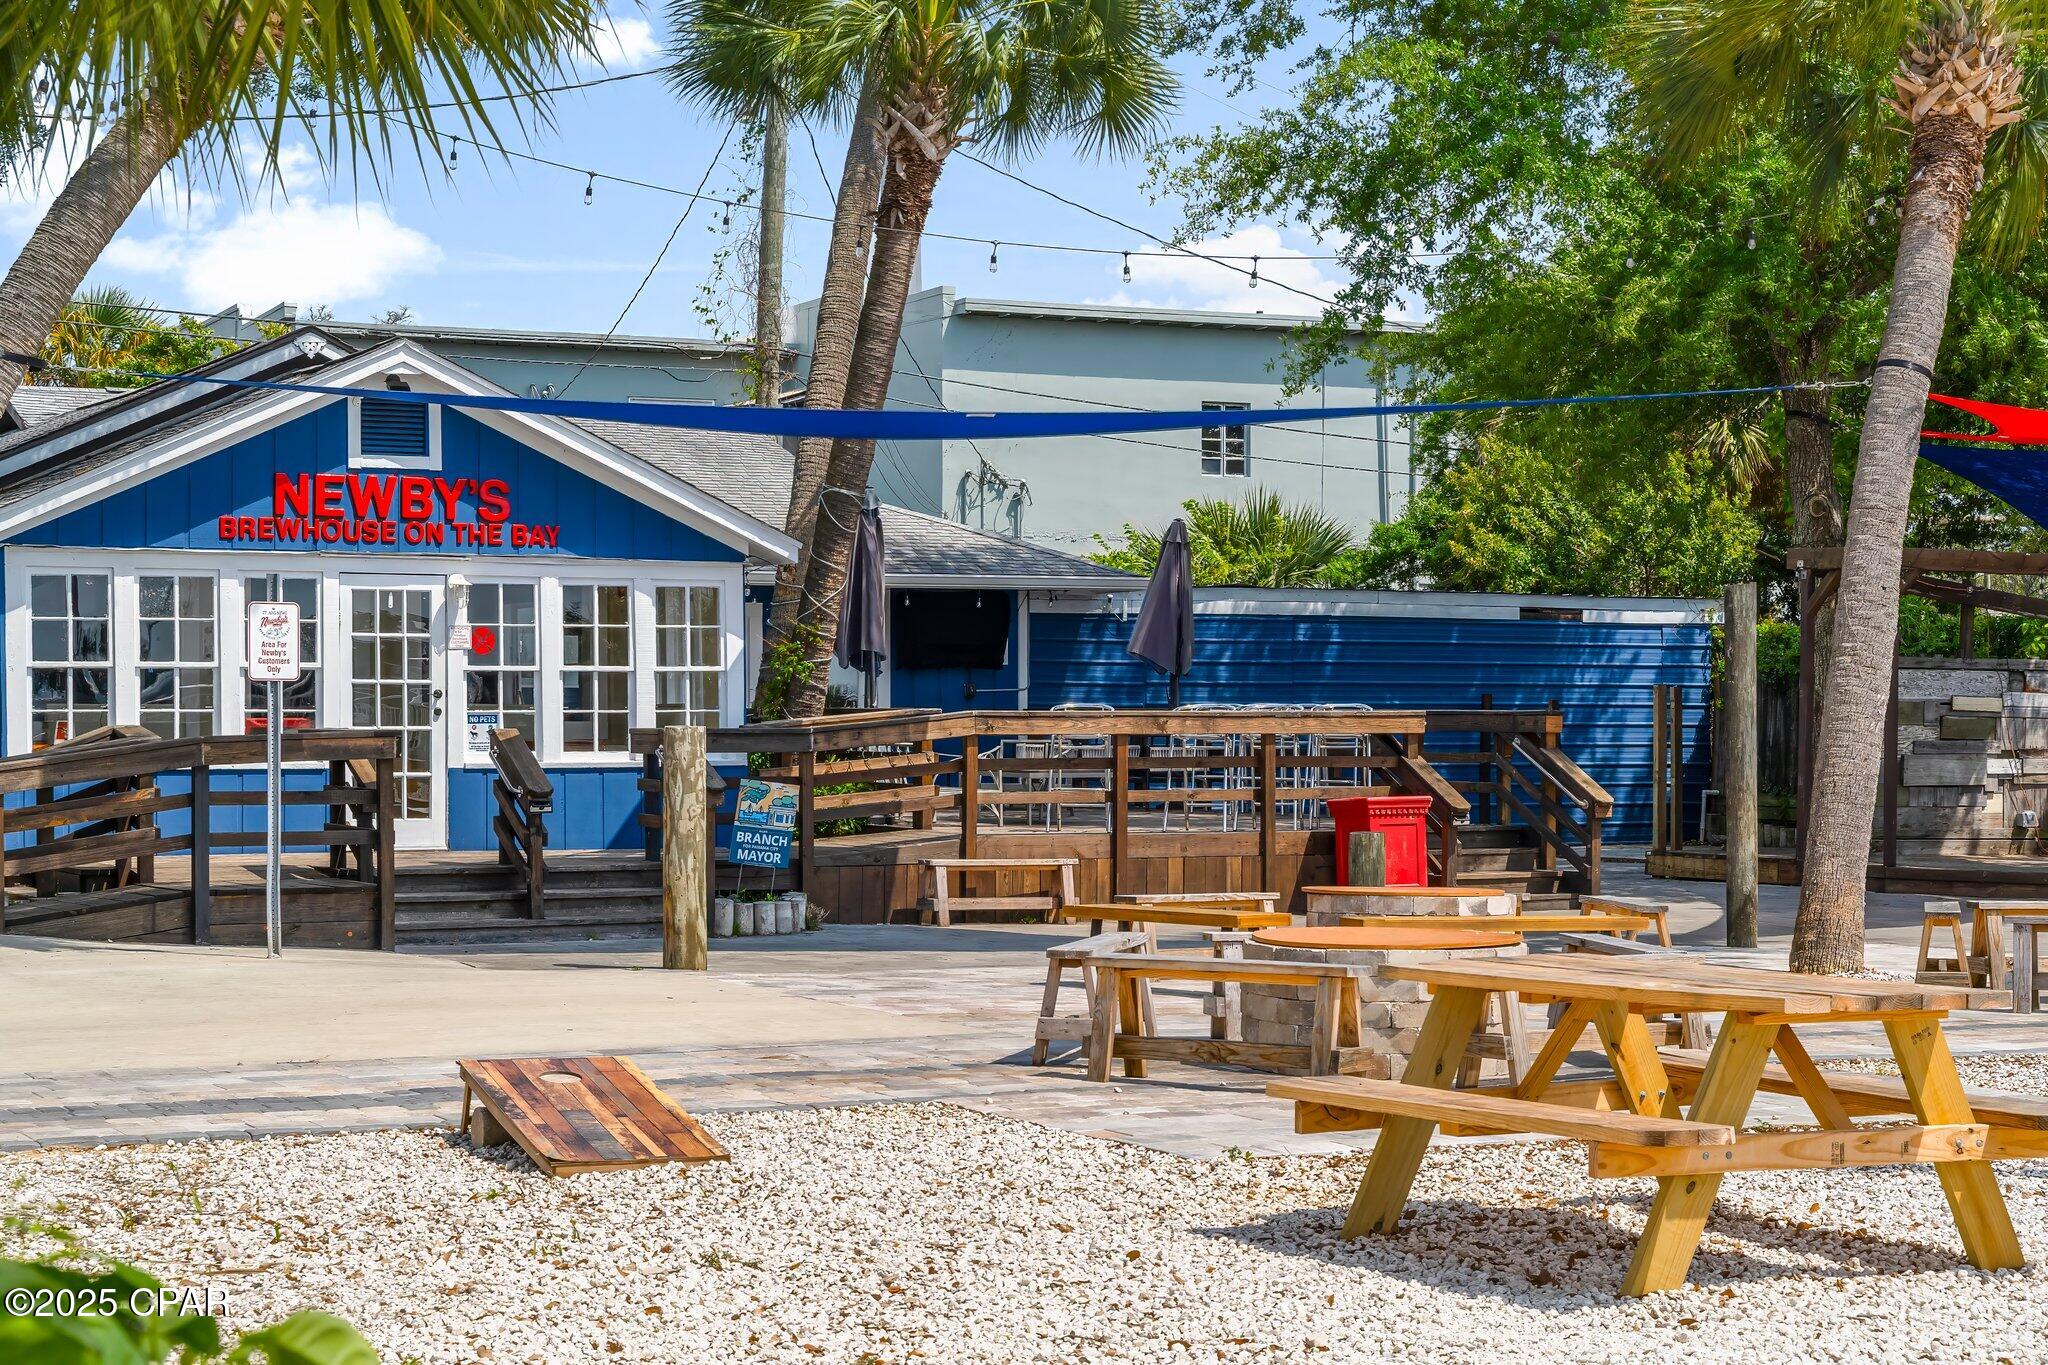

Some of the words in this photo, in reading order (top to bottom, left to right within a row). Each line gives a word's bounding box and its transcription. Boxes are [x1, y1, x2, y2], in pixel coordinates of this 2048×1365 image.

[273, 472, 511, 522] NEWBY'S
[218, 516, 397, 545] BREWHOUSE
[403, 520, 445, 546] ON
[456, 522, 503, 547] THE
[510, 524, 561, 549] BAY
[261, 649, 287, 657] Newby's
[258, 657, 291, 665] Customers
[267, 665, 281, 674] Only
[479, 715, 496, 723] PETS
[736, 831, 787, 846] BRANCH
[737, 849, 781, 863] MAYOR
